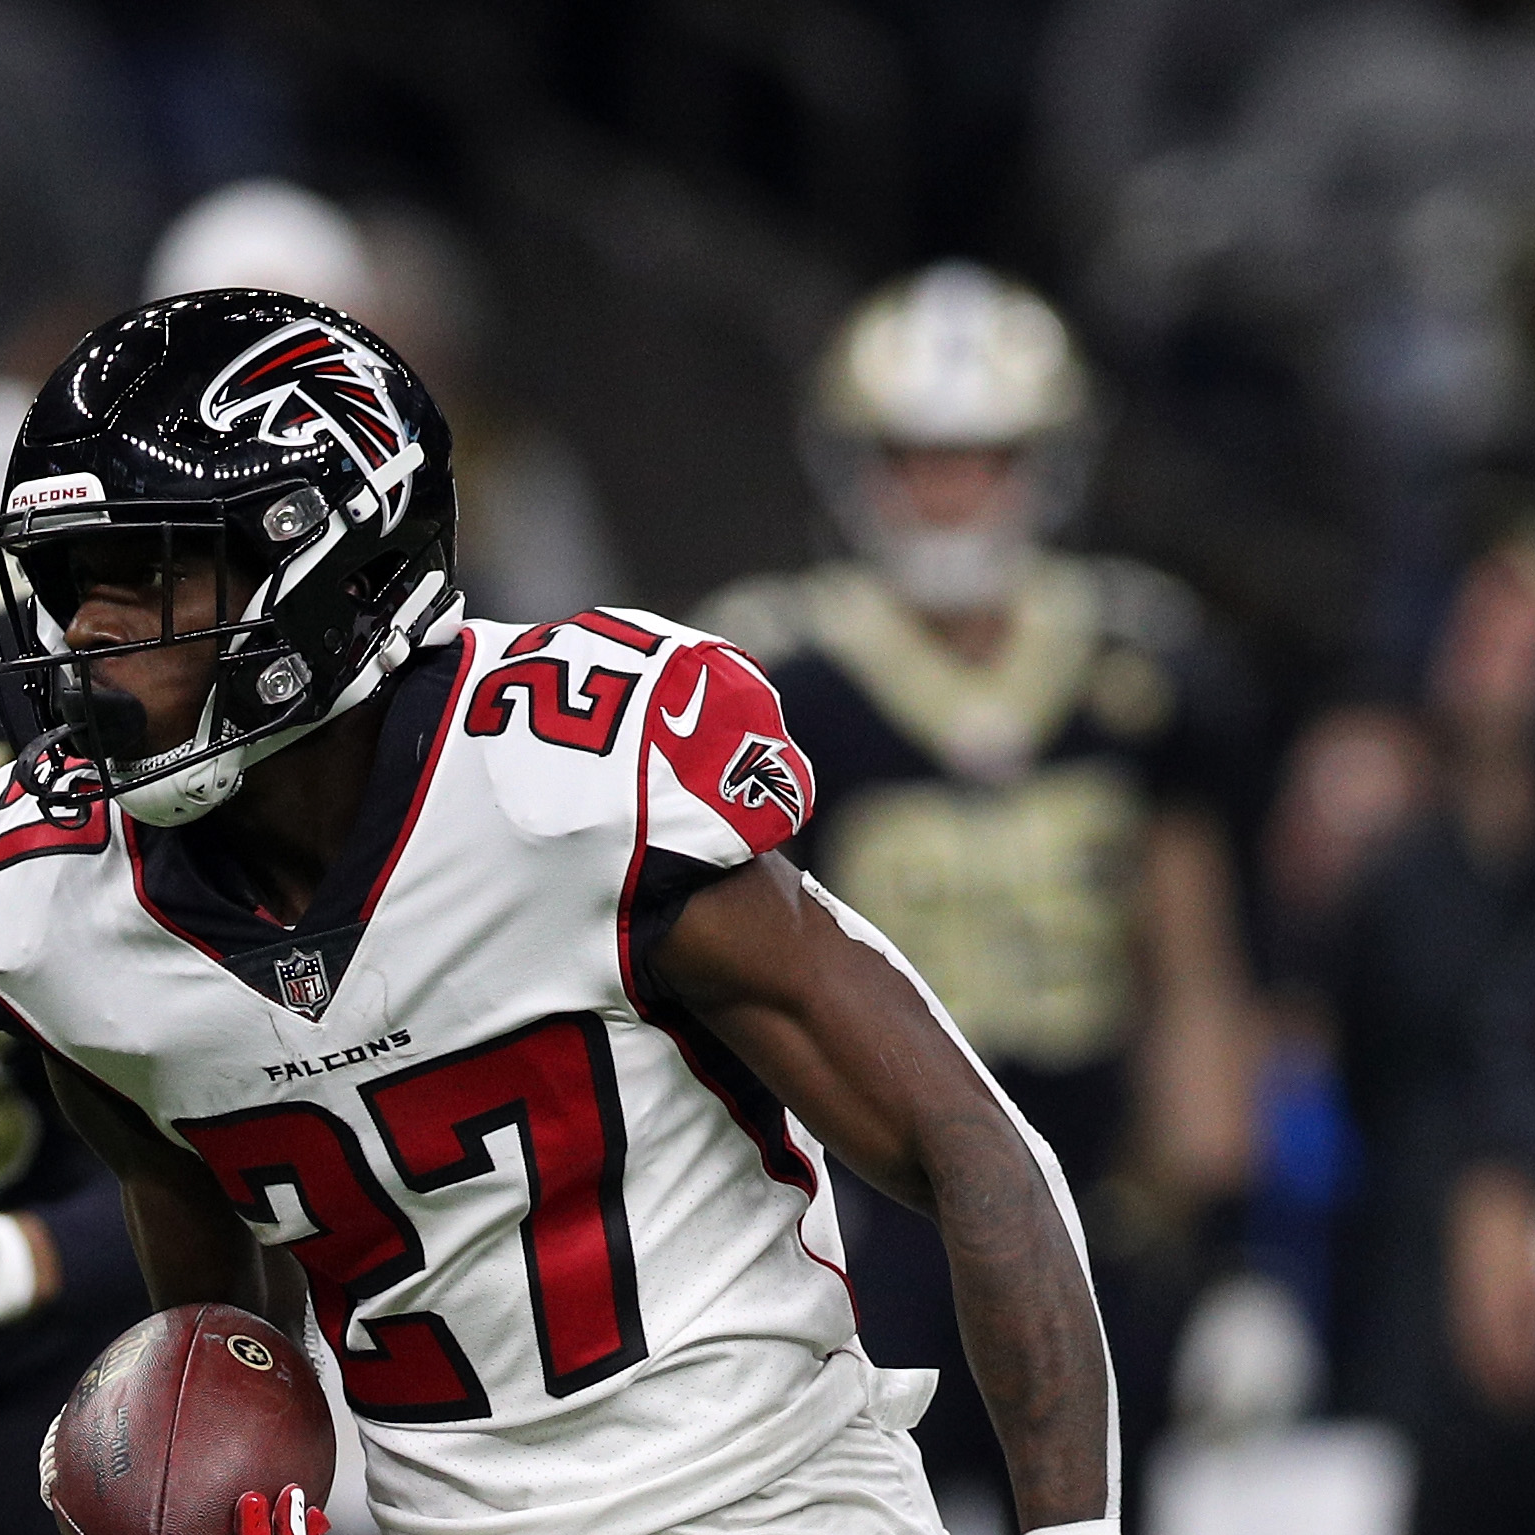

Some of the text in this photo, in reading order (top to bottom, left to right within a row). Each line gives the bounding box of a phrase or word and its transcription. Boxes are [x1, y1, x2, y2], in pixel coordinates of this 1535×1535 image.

[12, 486, 87, 509] FALCONS
[287, 976, 324, 1004] NFL
[262, 1028, 412, 1082] FALCONS
[173, 1010, 650, 1423] 27
